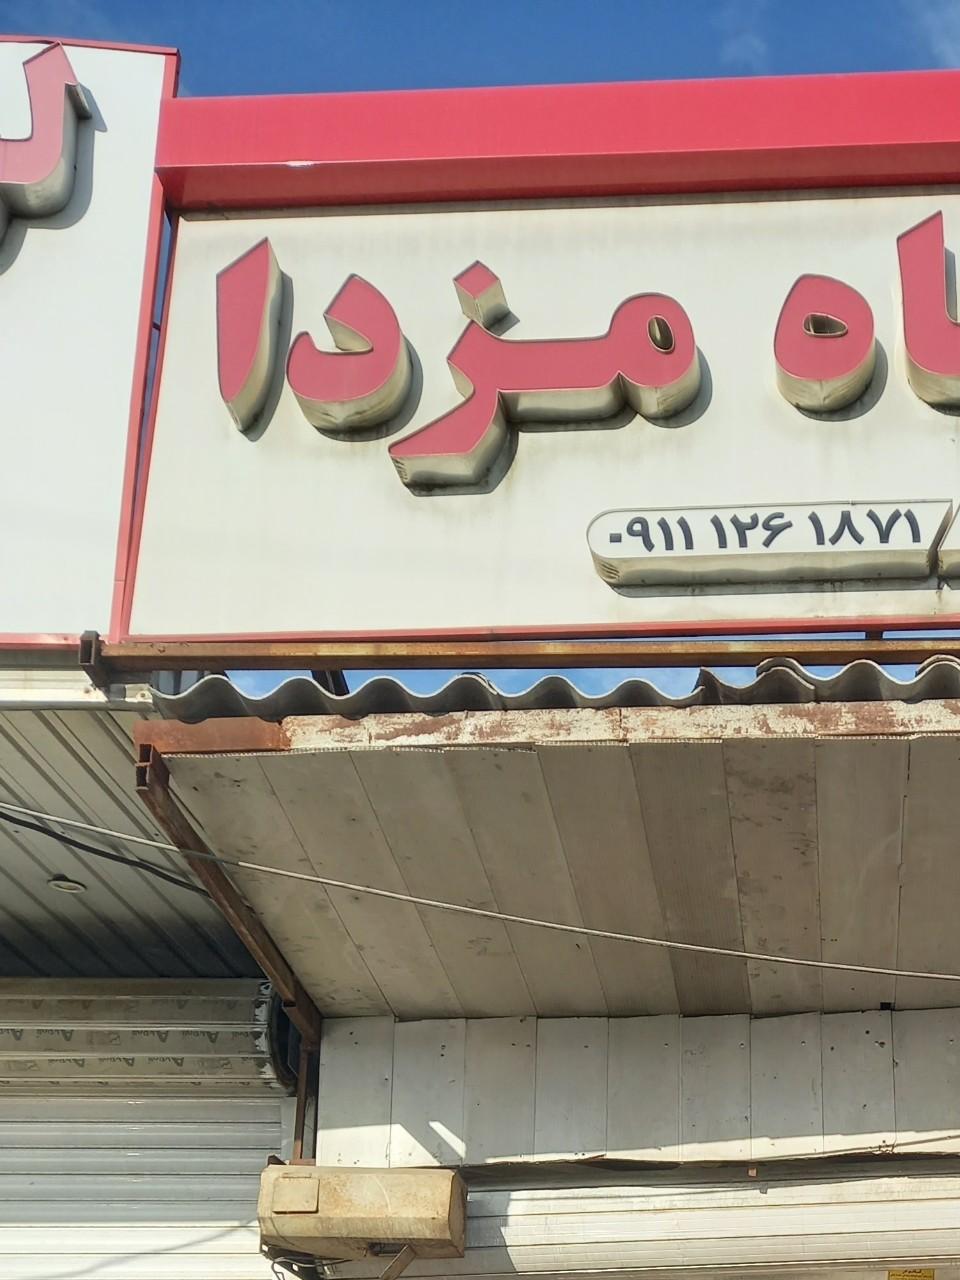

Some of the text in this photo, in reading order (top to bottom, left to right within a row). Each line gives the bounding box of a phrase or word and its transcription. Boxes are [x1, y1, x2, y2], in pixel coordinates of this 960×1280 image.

[215, 238, 697, 466] مزدا
[609, 508, 922, 553] ۰۹۱۱ ۱۲۶ ۱۸۷۱
